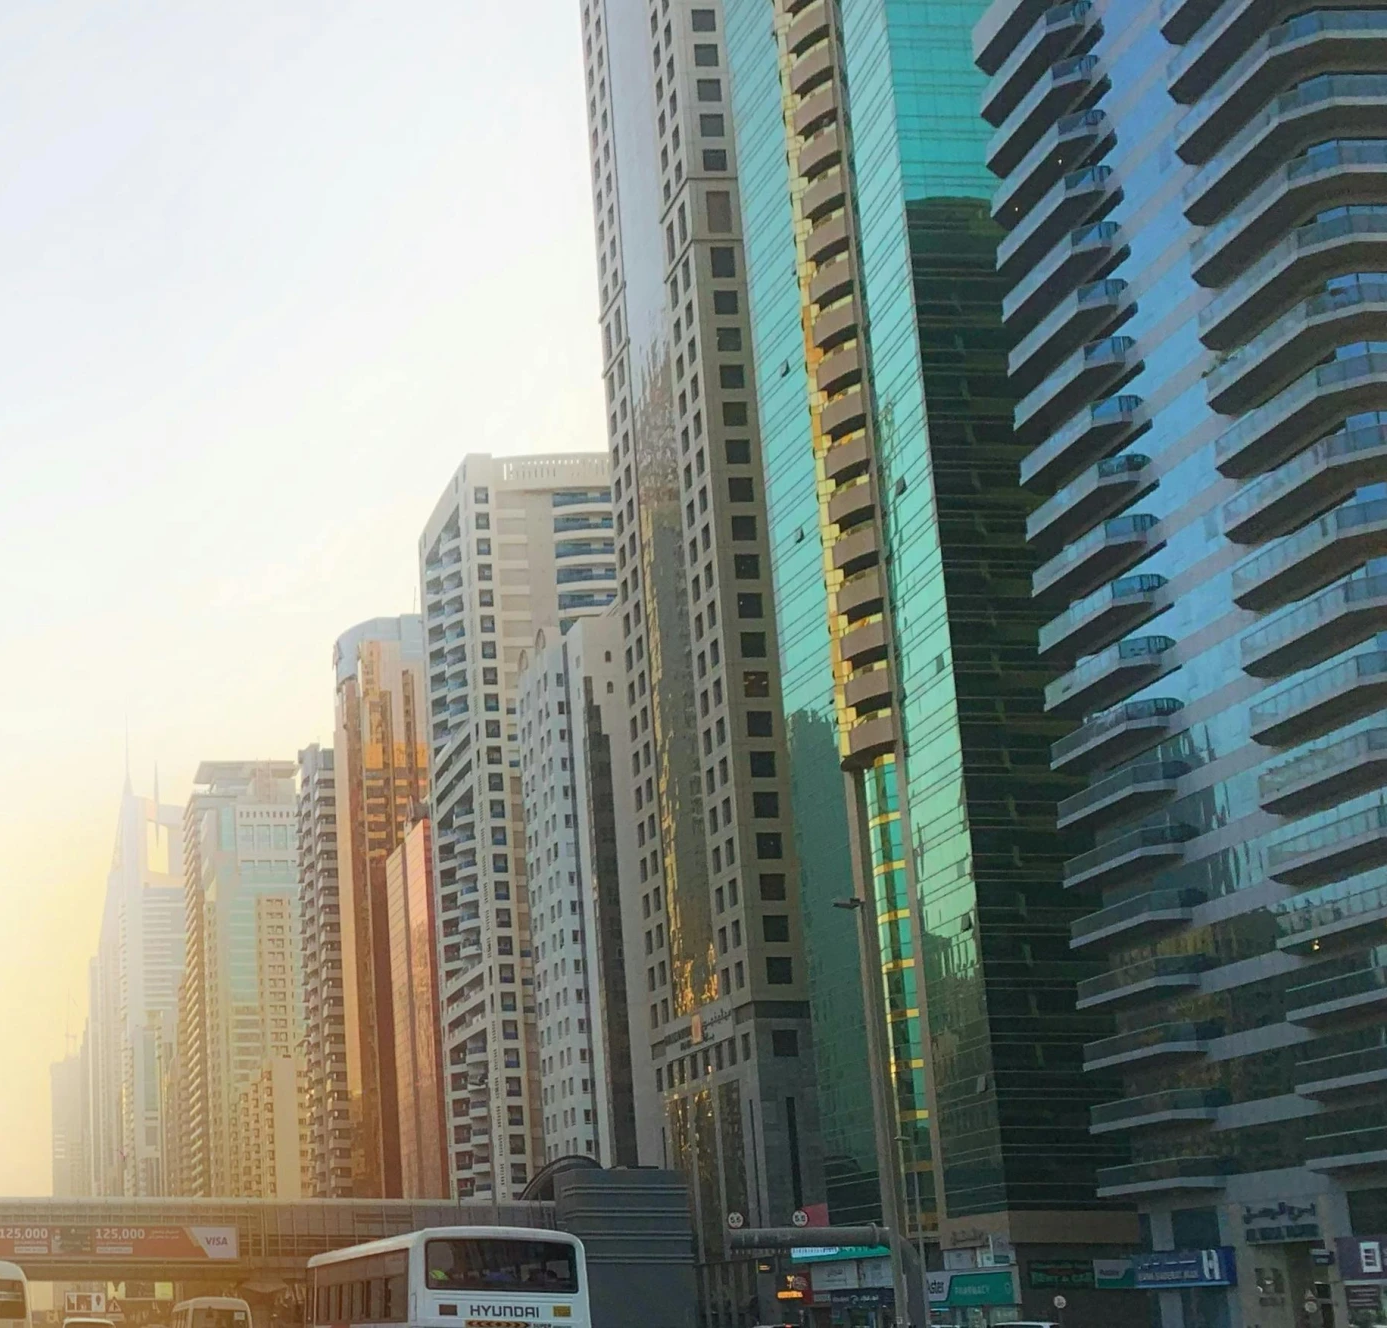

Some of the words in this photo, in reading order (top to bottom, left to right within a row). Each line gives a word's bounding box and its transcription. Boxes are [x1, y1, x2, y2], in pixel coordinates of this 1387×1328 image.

[95, 1228, 145, 1240] 125,000
[205, 1236, 228, 1246] VISA
[954, 1284, 990, 1295] PHARMACY
[470, 1304, 539, 1318] HYUNDAI
